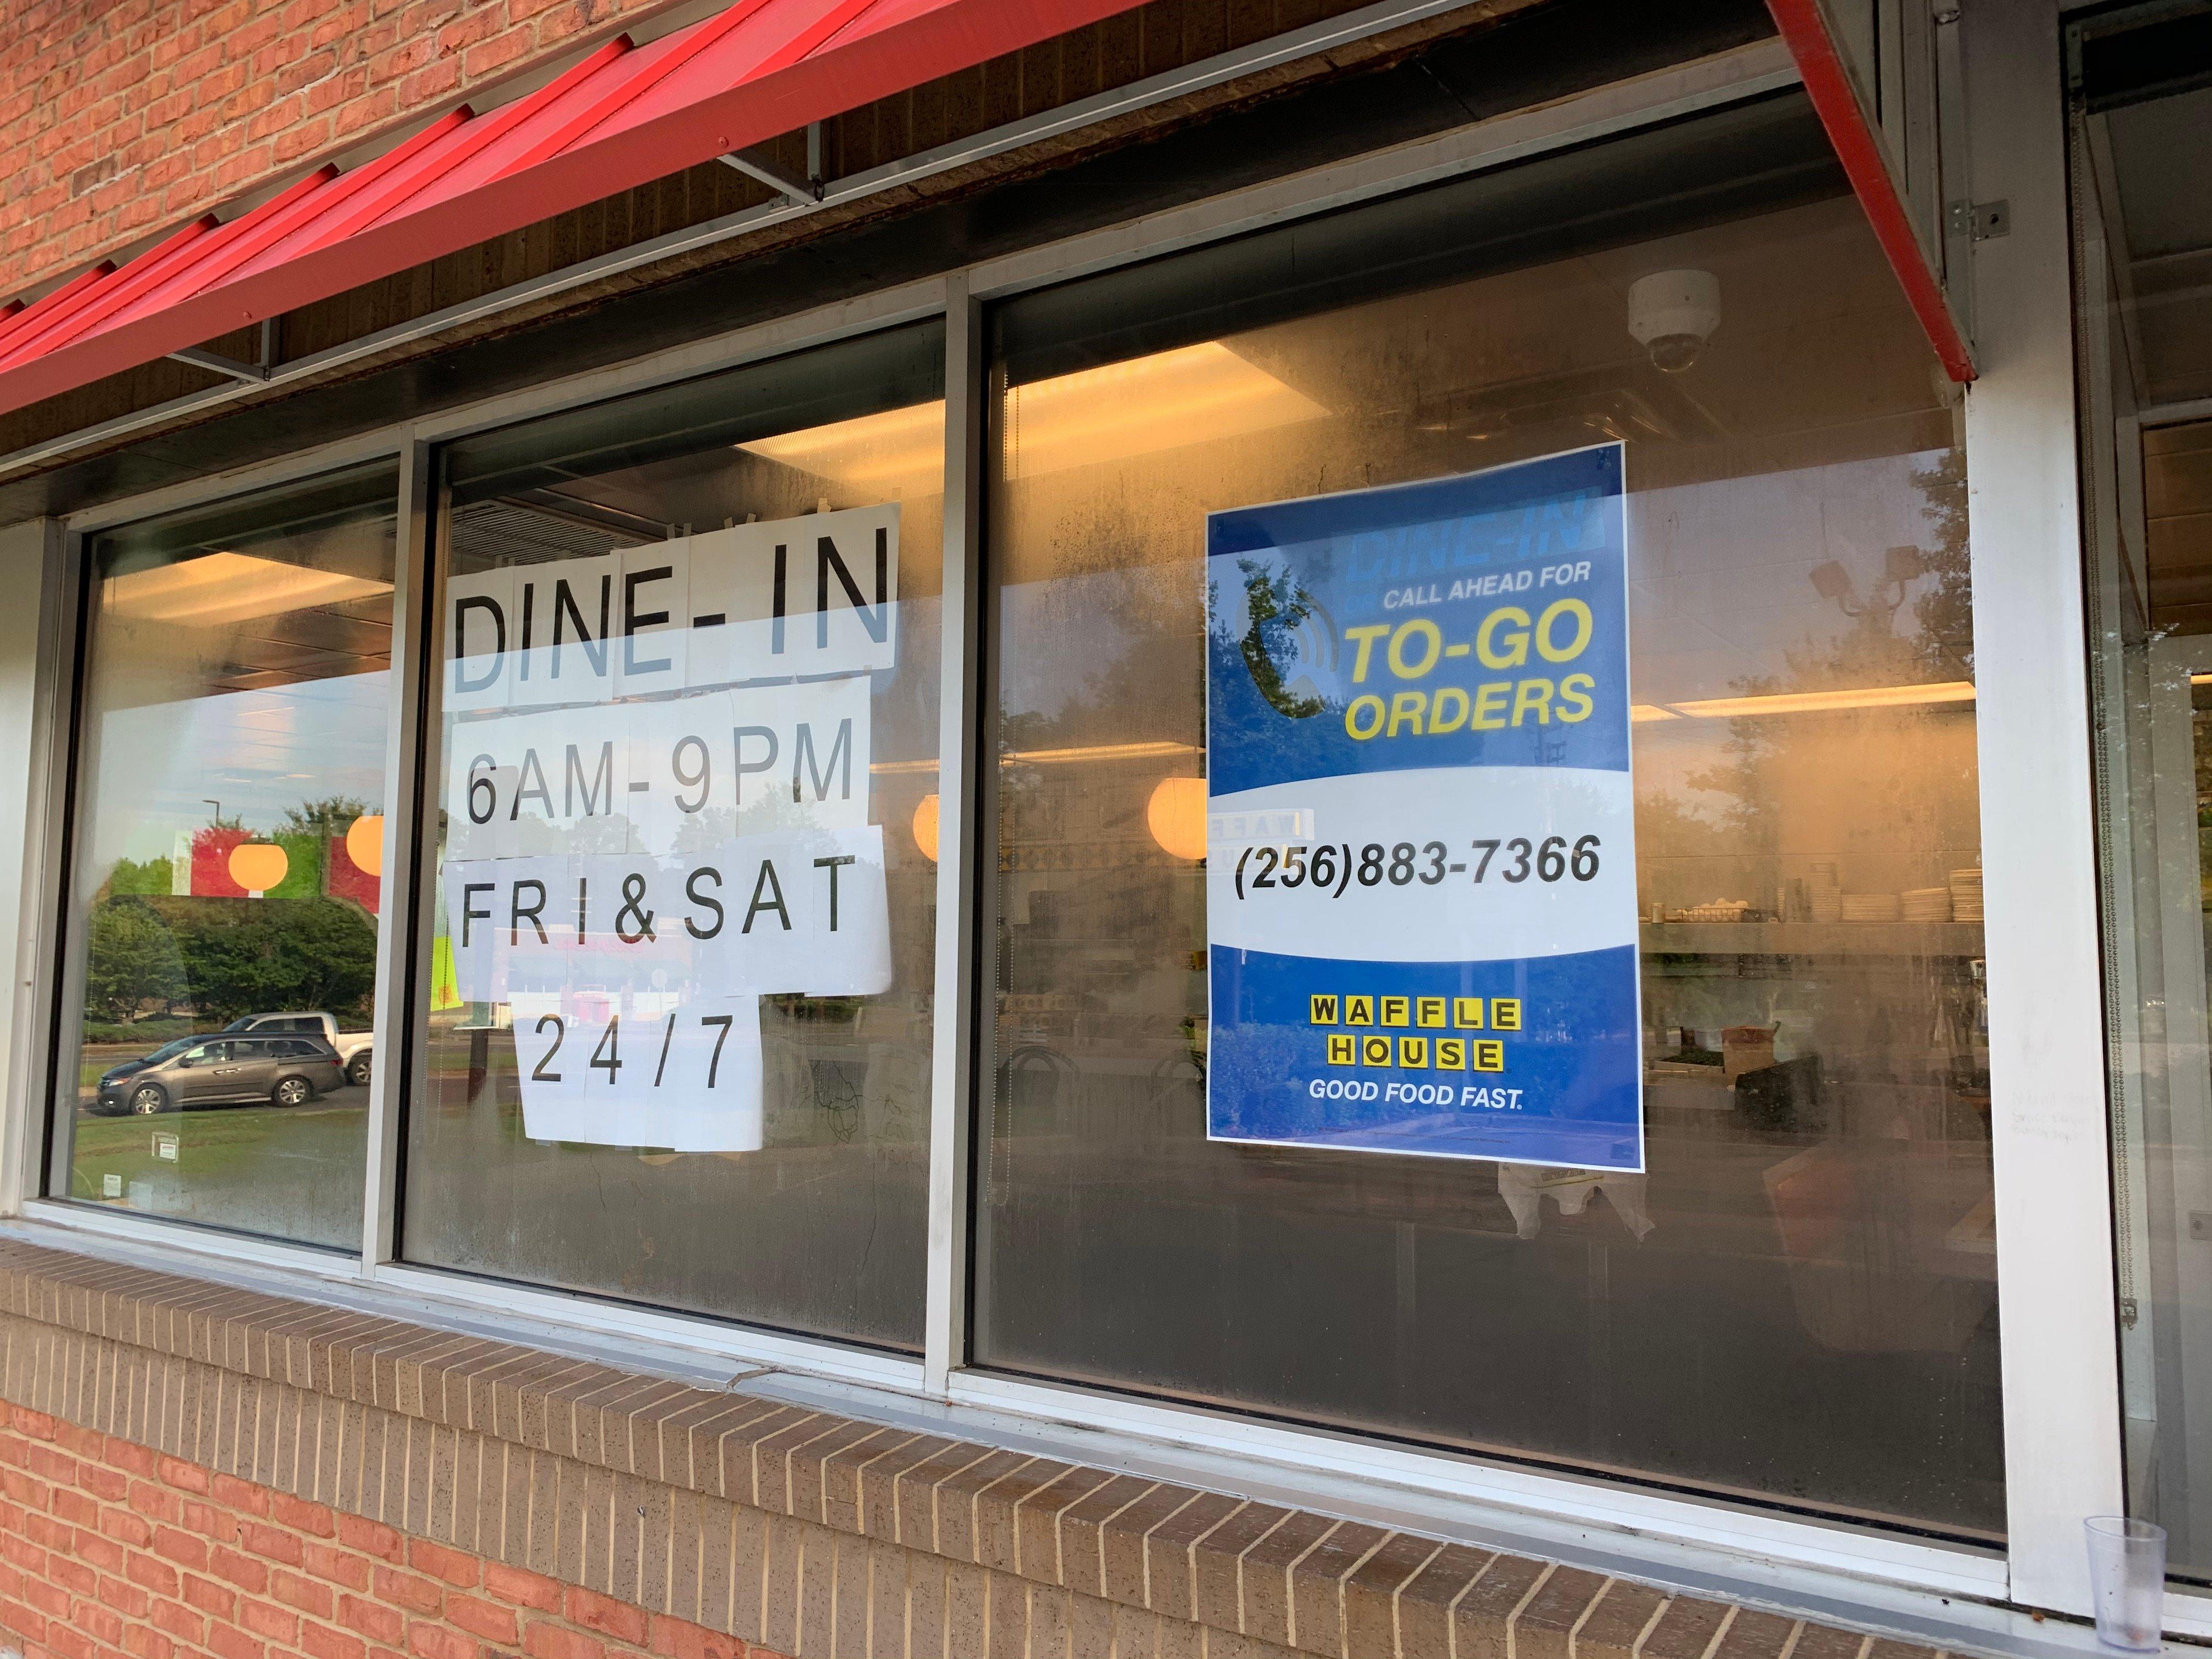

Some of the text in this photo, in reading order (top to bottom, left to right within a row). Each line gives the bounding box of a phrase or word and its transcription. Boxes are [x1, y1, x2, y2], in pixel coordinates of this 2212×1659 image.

[1383, 580, 1441, 610] CALL
[1447, 569, 1533, 601] AHEAD
[1539, 560, 1592, 588] FOR
[1344, 598, 1594, 683] TO-GO
[1344, 673, 1596, 741] ORDERS
[1234, 834, 1601, 900] (256)883-7366
[1312, 997, 1519, 1029] WAFFLE
[531, 1013, 733, 1089] 24/7
[1330, 1037, 1500, 1070] HOUSE
[1309, 1078, 1379, 1102] GOOD
[1384, 1082, 1455, 1105] FOOD
